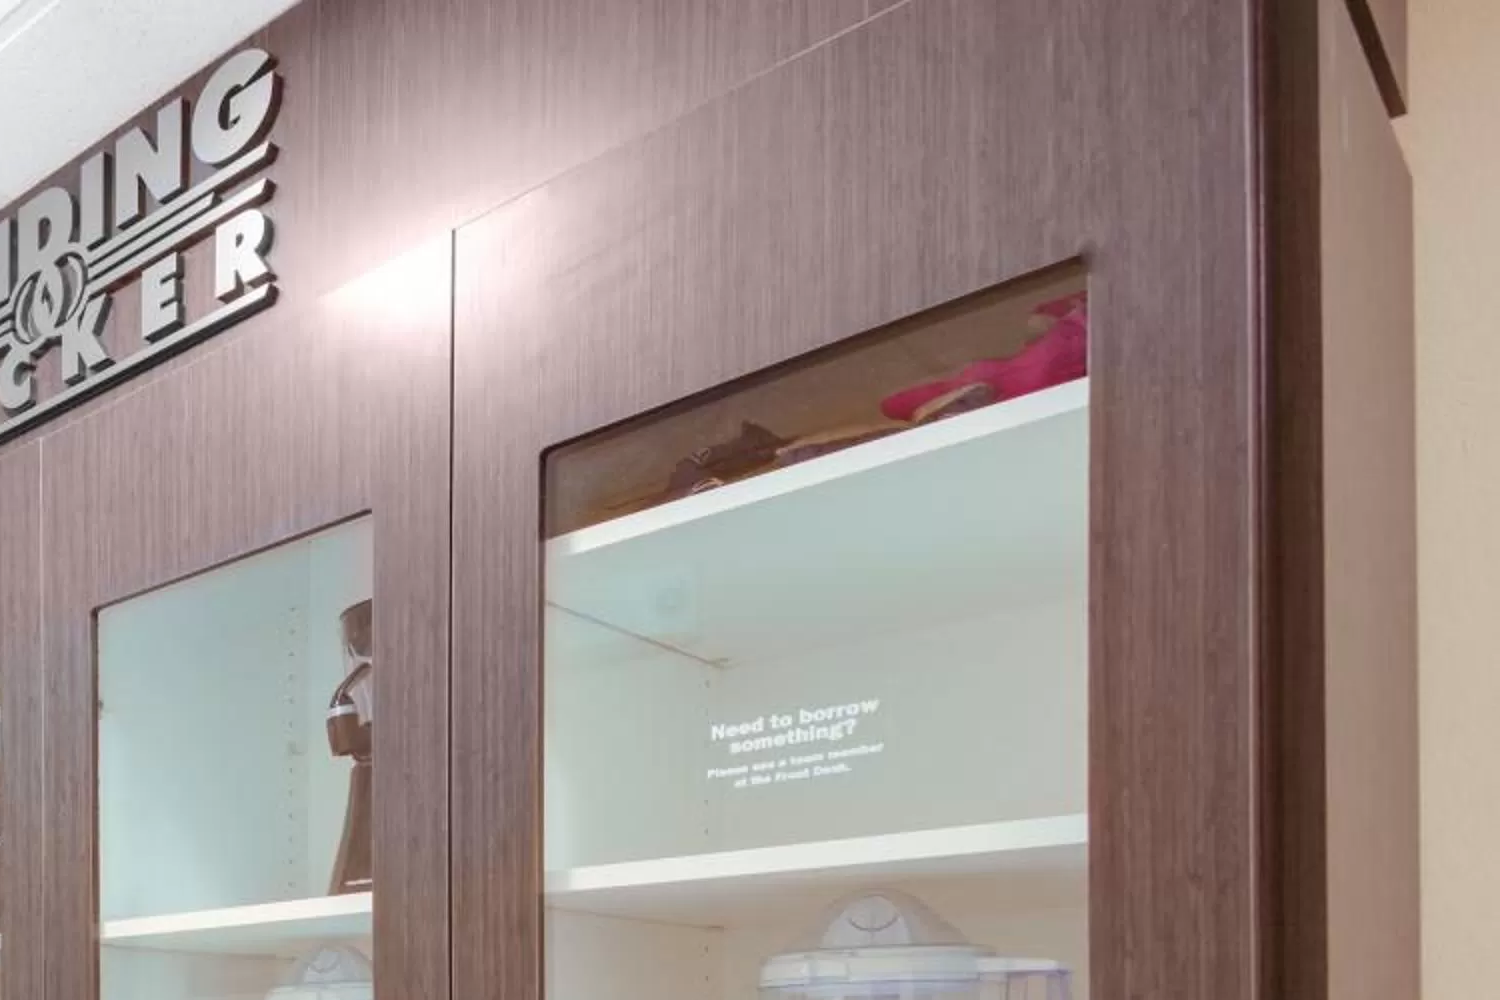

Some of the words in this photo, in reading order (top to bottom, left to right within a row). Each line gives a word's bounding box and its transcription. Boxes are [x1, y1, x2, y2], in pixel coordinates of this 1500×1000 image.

[711, 716, 764, 741] Need
[770, 713, 793, 729] to
[799, 699, 880, 724] borrow
[730, 718, 858, 754] something?
